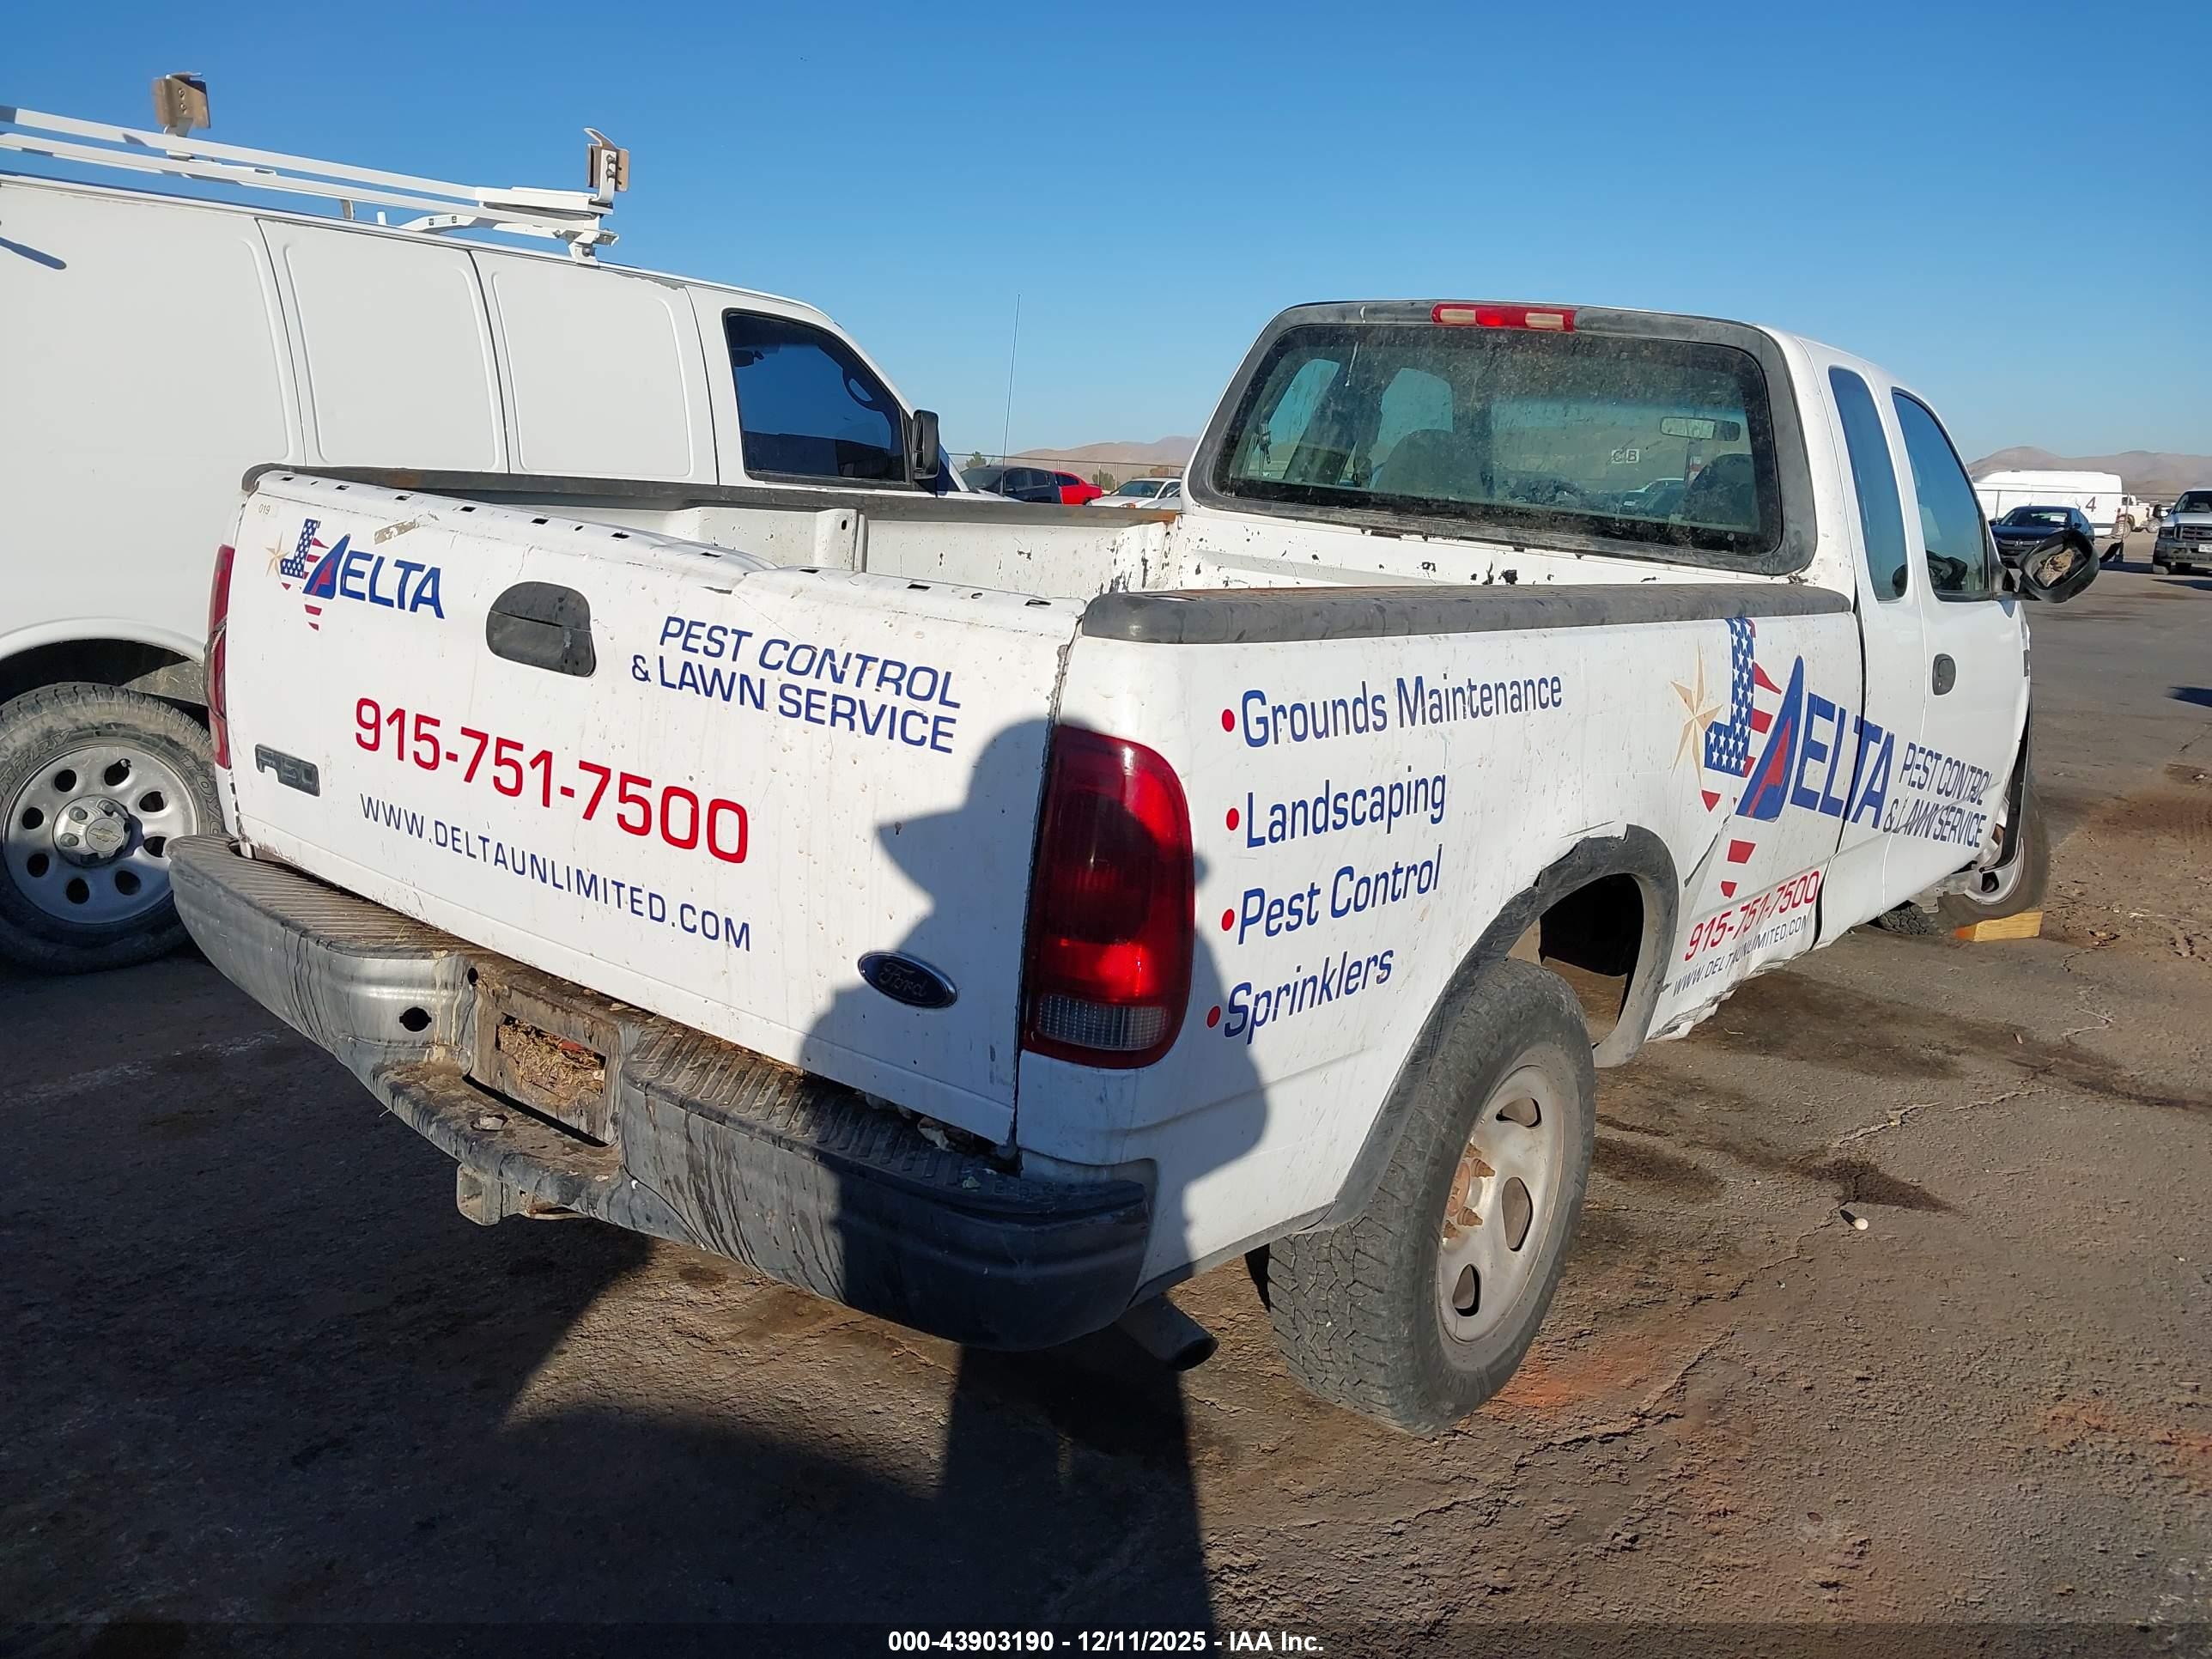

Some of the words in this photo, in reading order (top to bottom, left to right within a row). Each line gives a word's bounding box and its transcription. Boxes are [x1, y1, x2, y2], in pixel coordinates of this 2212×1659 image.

[258, 503, 271, 515] 019
[2085, 495, 2097, 513] 4
[632, 654, 652, 683] &
[659, 656, 766, 711] LAWN
[778, 684, 957, 754] SERVICE
[659, 617, 753, 662] PEST
[758, 639, 961, 709] CONTROL
[1241, 681, 1389, 748] Grounds
[1395, 673, 1563, 728] Maintenance
[356, 697, 749, 864] 915-751-7500
[1246, 765, 1447, 848] Landscaping
[1899, 742, 1943, 792] PEST
[1936, 757, 1993, 806] CONTROL
[1882, 798, 1899, 834] &
[1892, 796, 1941, 839] LAWN
[1932, 805, 1987, 848] SERVICE
[360, 793, 751, 952] WWW.DELTAUNLIMITED.COM
[1237, 882, 1321, 945] Pest
[1330, 843, 1443, 920] Control
[1684, 870, 1820, 962] 915-751-7500
[1223, 948, 1395, 1045] Sprinklers
